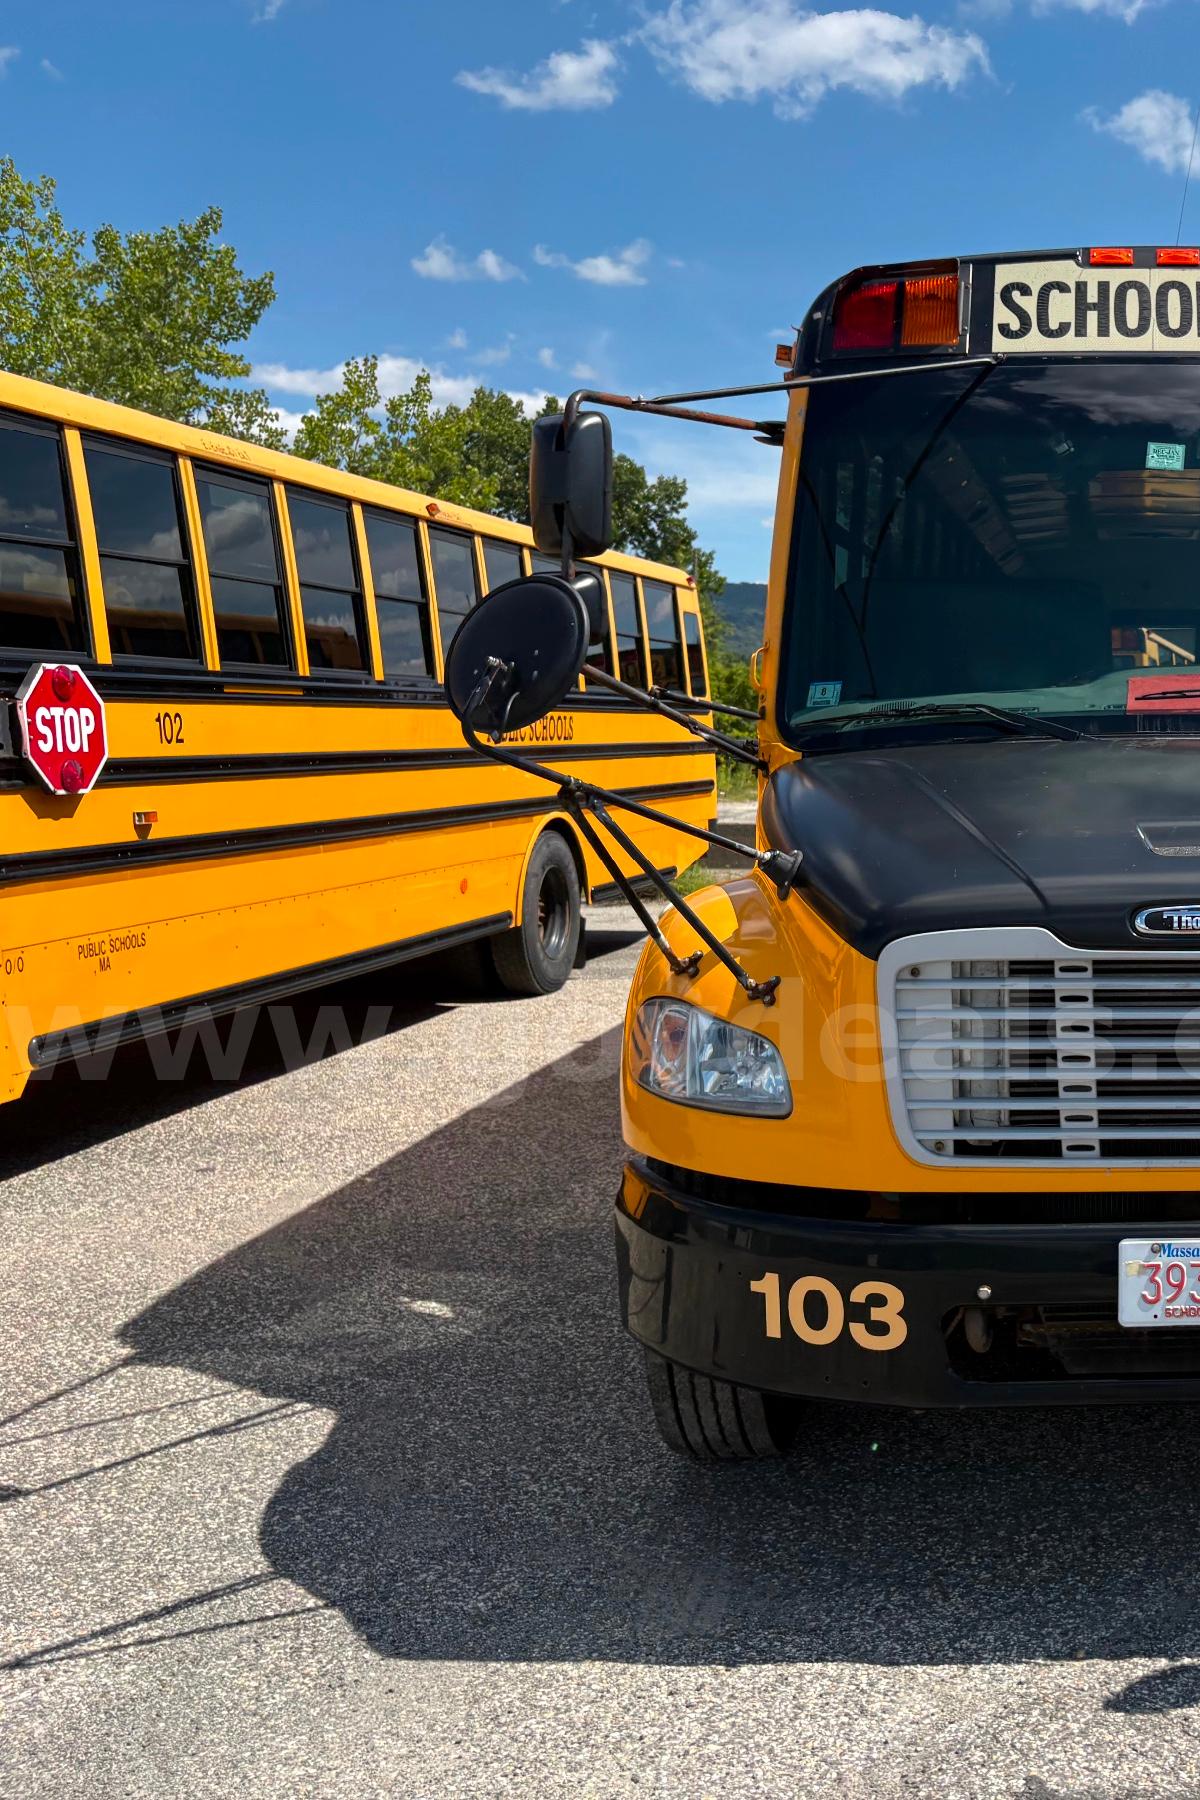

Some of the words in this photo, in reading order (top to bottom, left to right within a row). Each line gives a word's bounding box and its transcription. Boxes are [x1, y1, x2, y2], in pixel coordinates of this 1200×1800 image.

[35, 706, 95, 753] STOP
[155, 711, 184, 745] 102
[77, 940, 106, 960] PUBLIC
[109, 933, 147, 953] SCHOOLS
[99, 957, 112, 972] MA
[750, 1272, 908, 1351] 103
